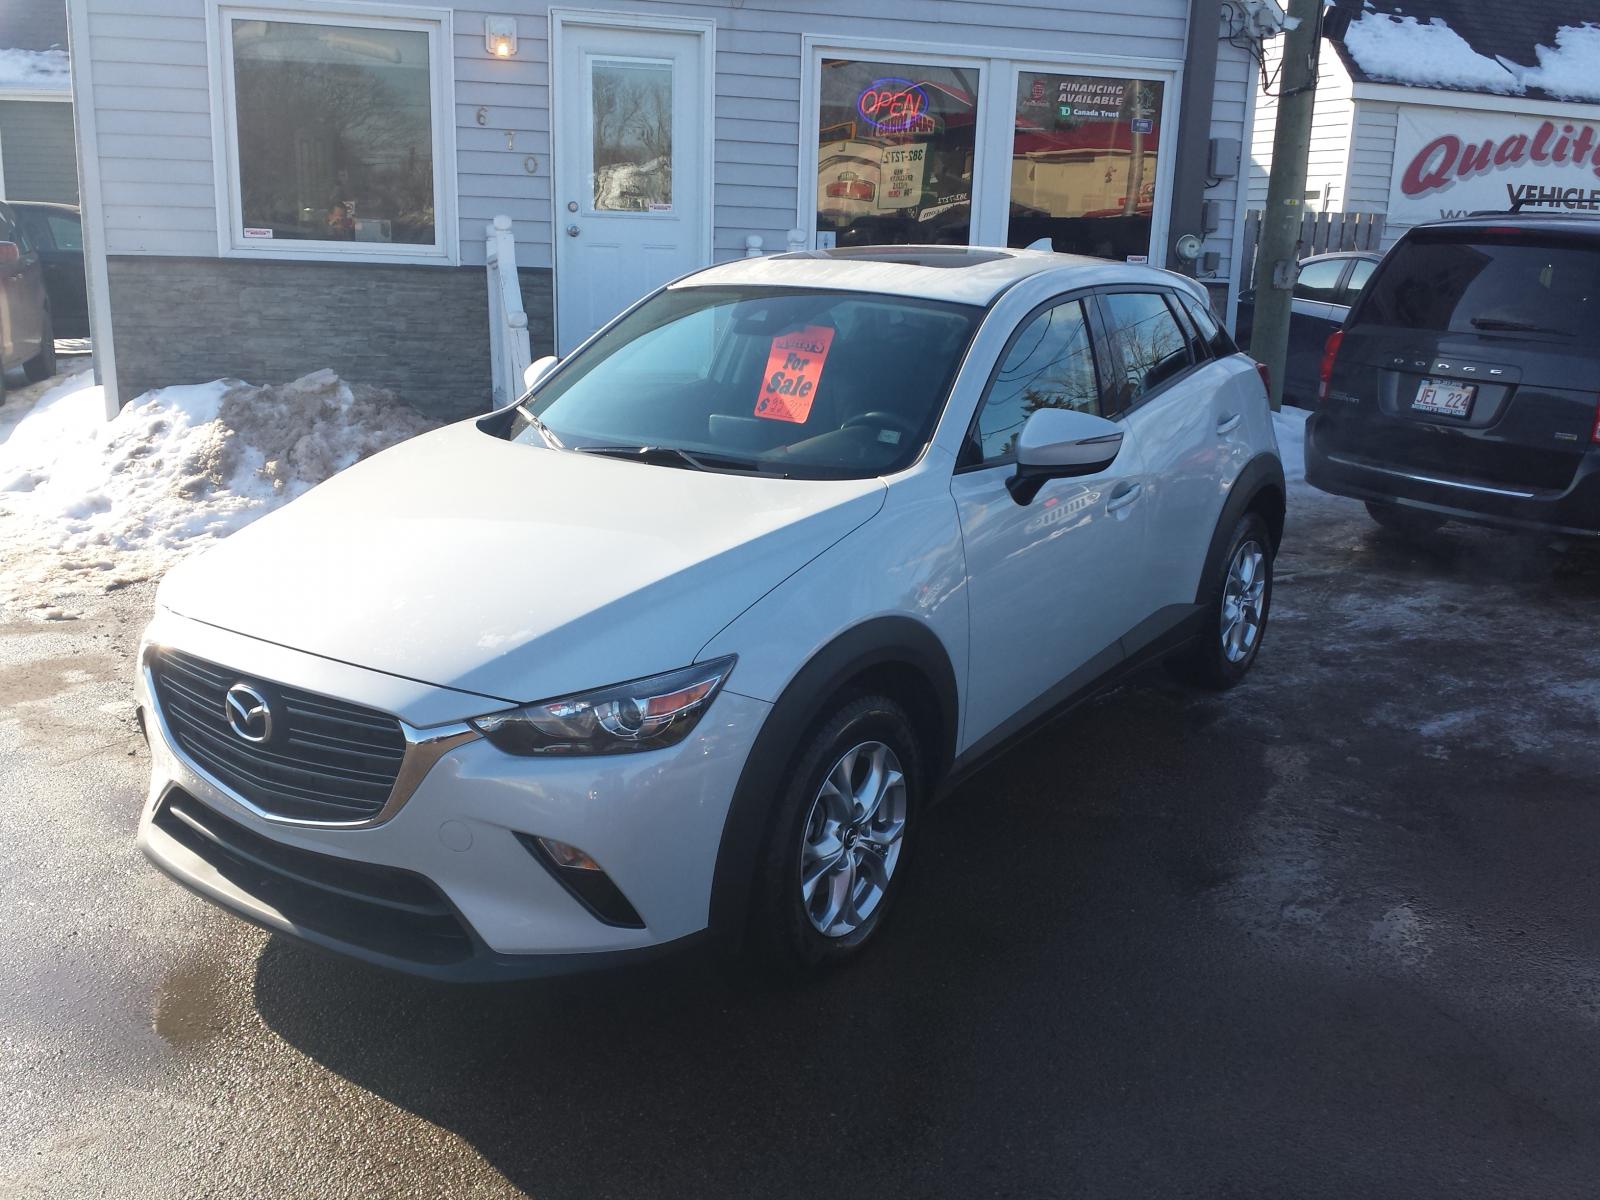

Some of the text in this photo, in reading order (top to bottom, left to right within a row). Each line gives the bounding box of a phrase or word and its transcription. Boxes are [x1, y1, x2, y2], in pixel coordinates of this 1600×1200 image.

[1059, 82, 1124, 95] FINANCING
[861, 90, 922, 117] OPEN
[1057, 93, 1124, 106] AVAILABLE
[1073, 108, 1099, 117] Canada
[1100, 110, 1120, 118] Trust
[783, 352, 810, 371] For
[766, 371, 813, 397] Sale
[1416, 388, 1438, 405] JEL
[1444, 392, 1471, 410] 224
